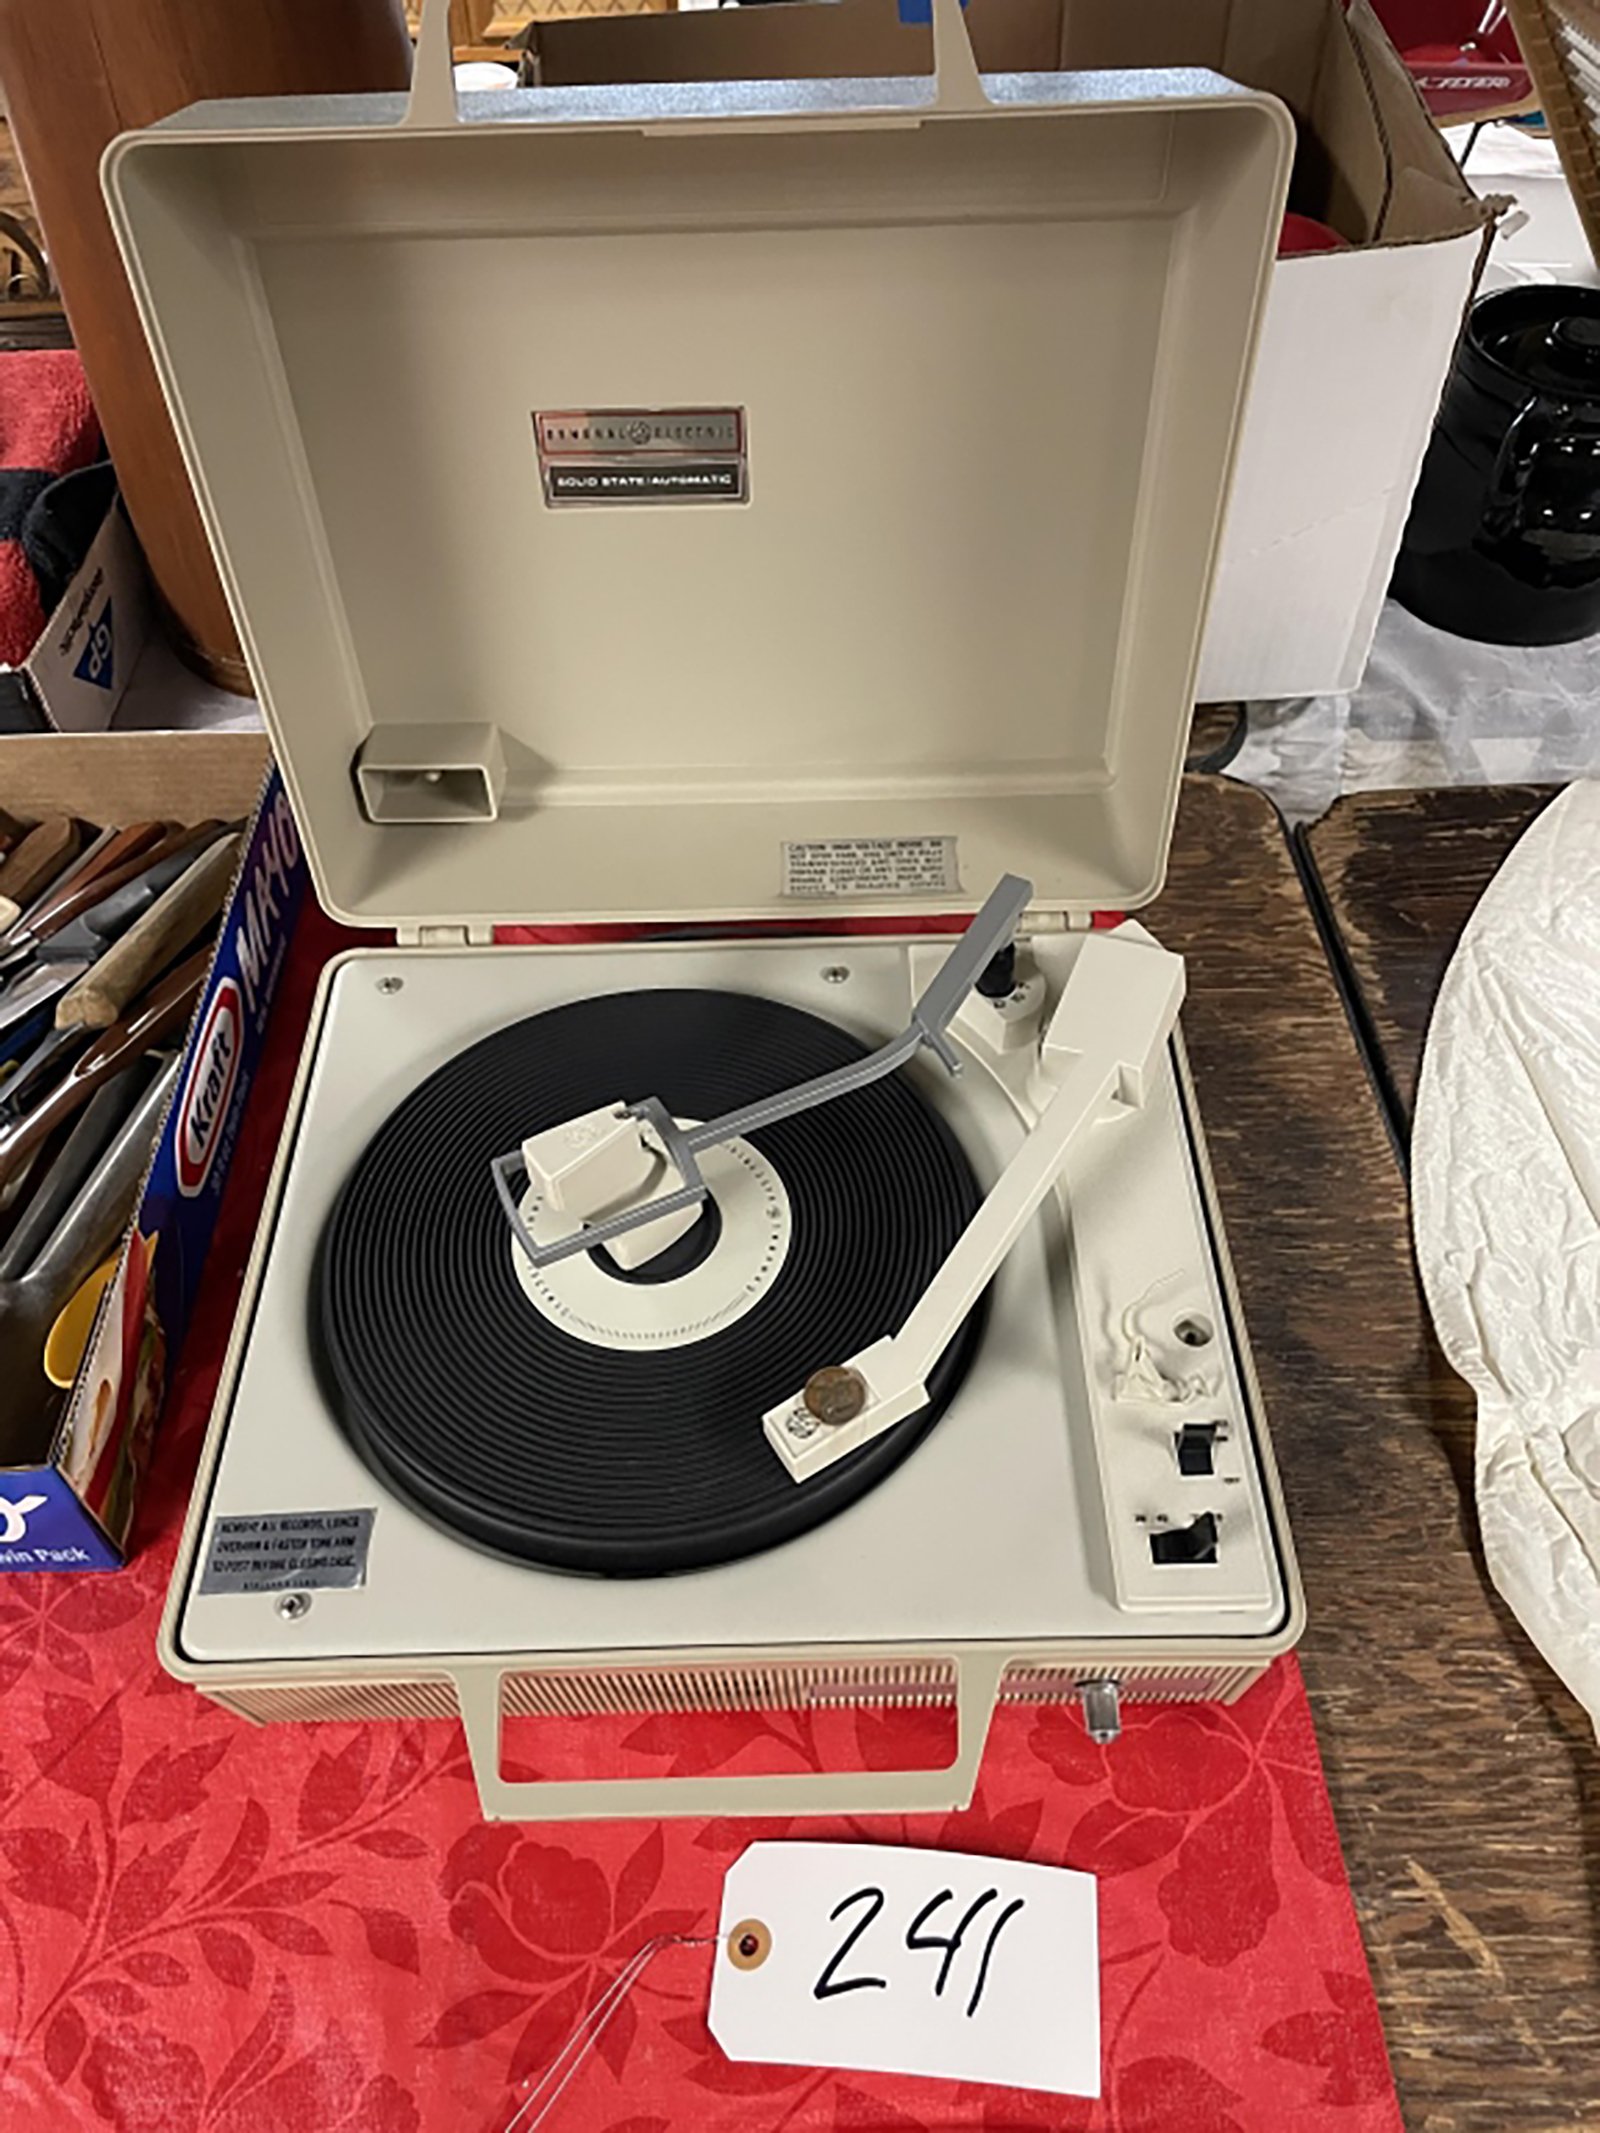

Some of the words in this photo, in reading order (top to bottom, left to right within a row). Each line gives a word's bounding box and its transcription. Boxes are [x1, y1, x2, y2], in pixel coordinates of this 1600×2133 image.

[557, 476, 598, 487] SOLID
[89, 623, 112, 679] GP
[190, 1028, 231, 1149] Kraft
[33, 1546, 91, 1562] Pack
[813, 1886, 1025, 2018] 241
